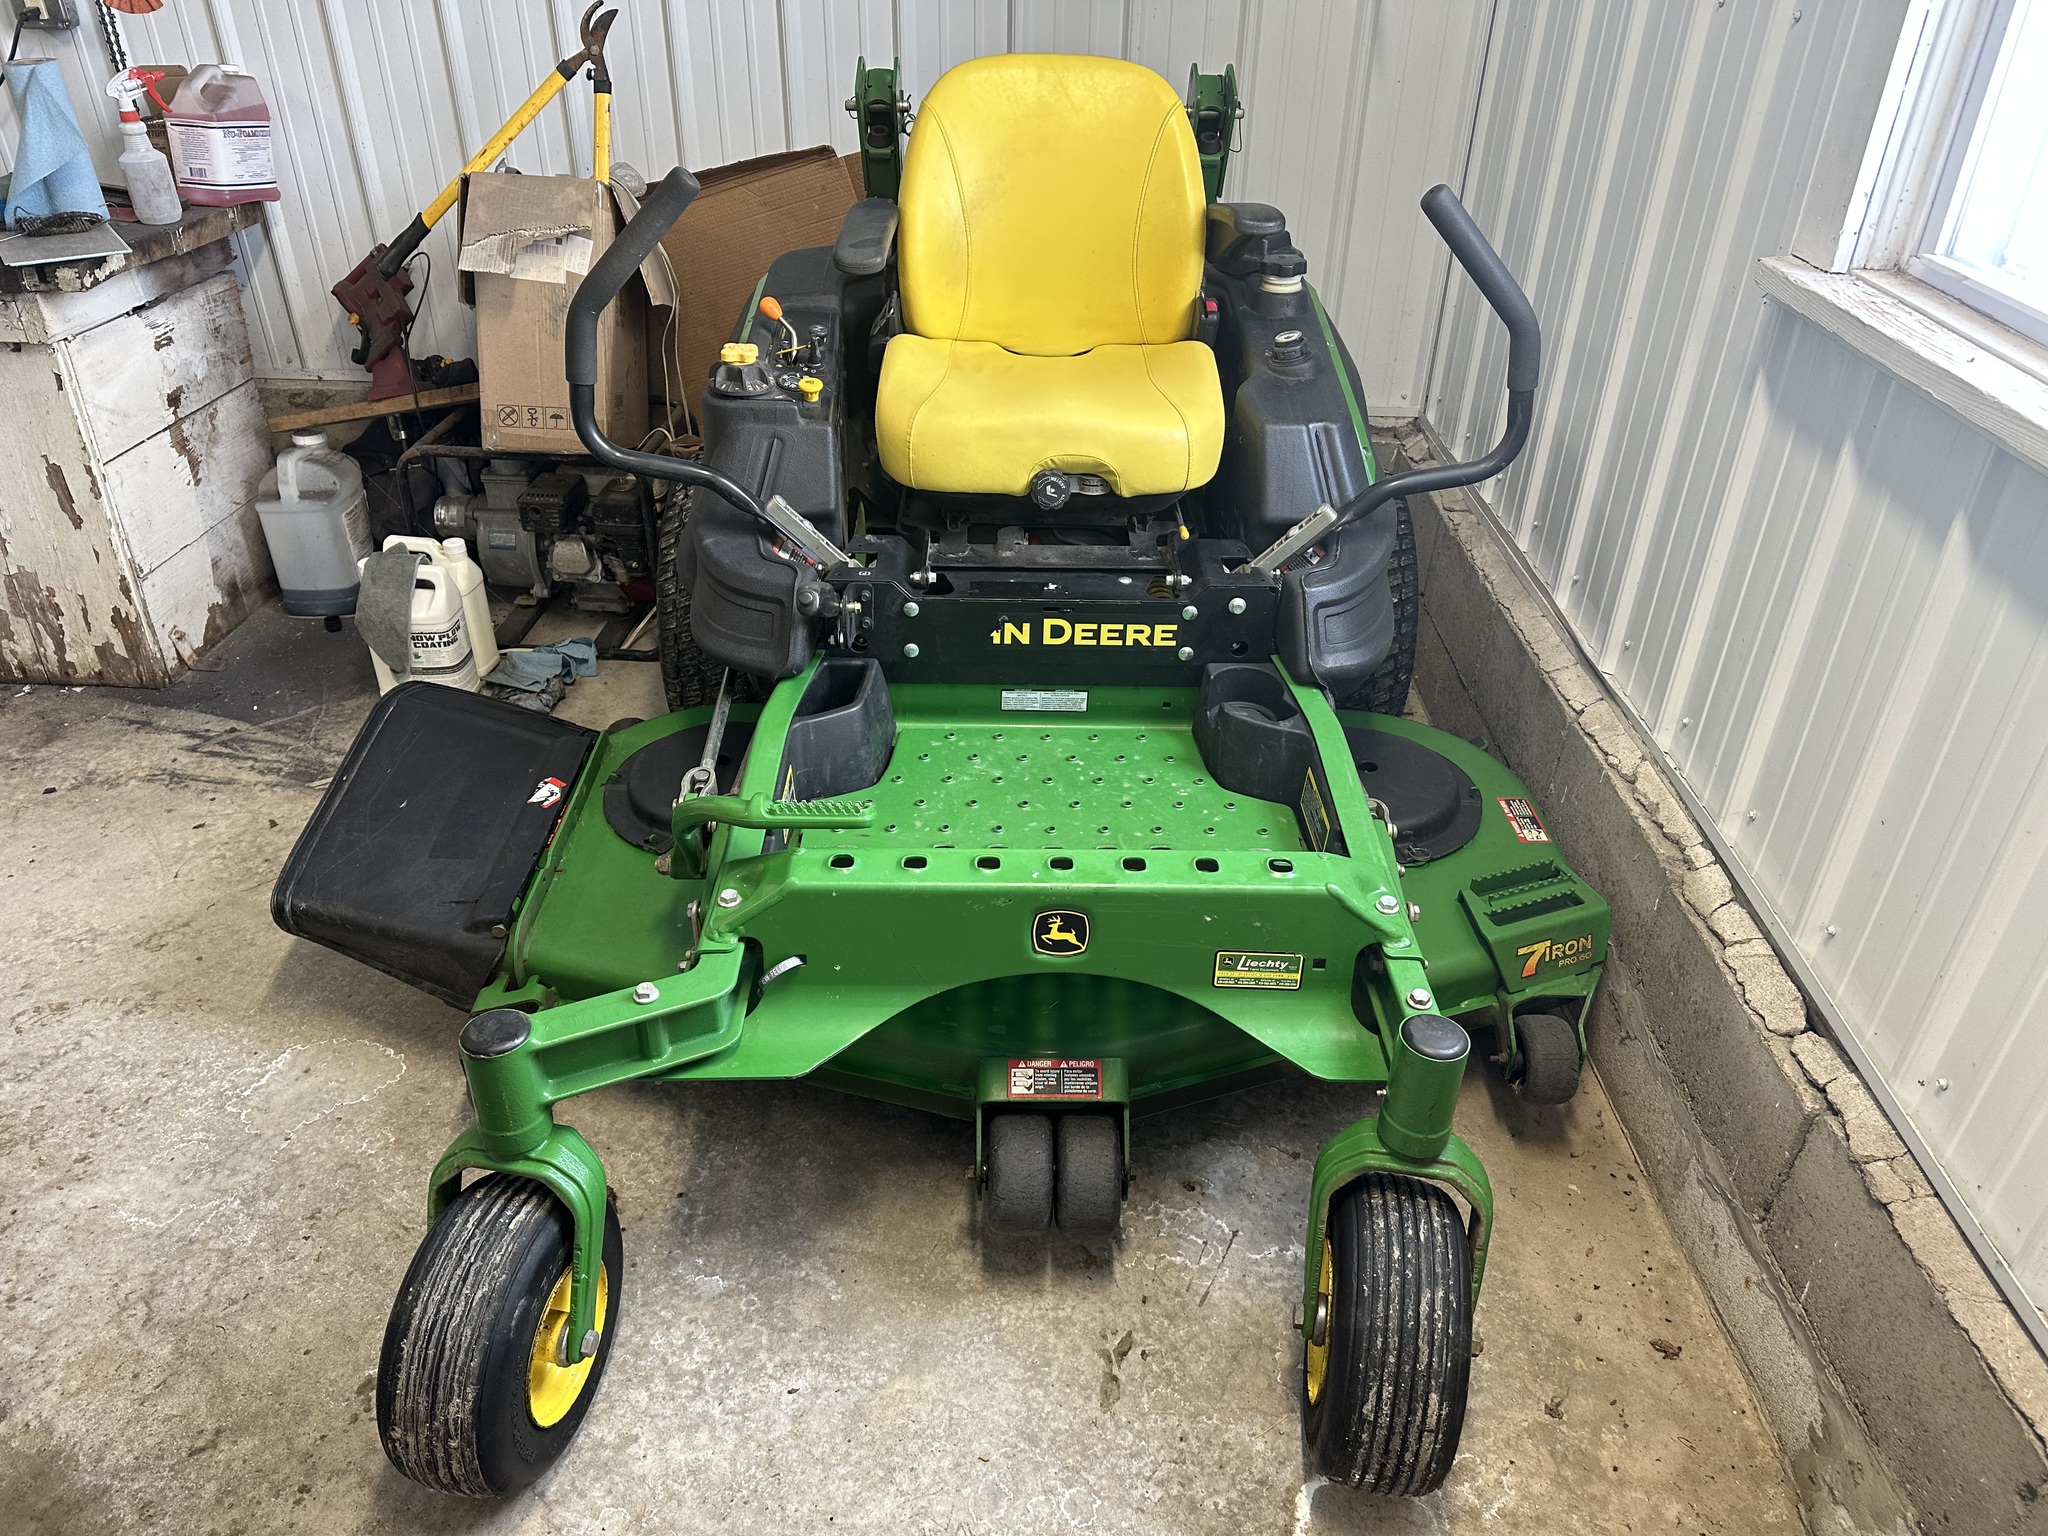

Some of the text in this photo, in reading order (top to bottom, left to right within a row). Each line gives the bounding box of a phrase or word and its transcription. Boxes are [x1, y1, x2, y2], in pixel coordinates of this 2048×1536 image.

[438, 622, 461, 641] PLOW
[1043, 618, 1178, 646] DEERE
[413, 634, 458, 648] COATING
[1237, 956, 1289, 970] Liechty
[1558, 952, 1592, 968] PRO 60
